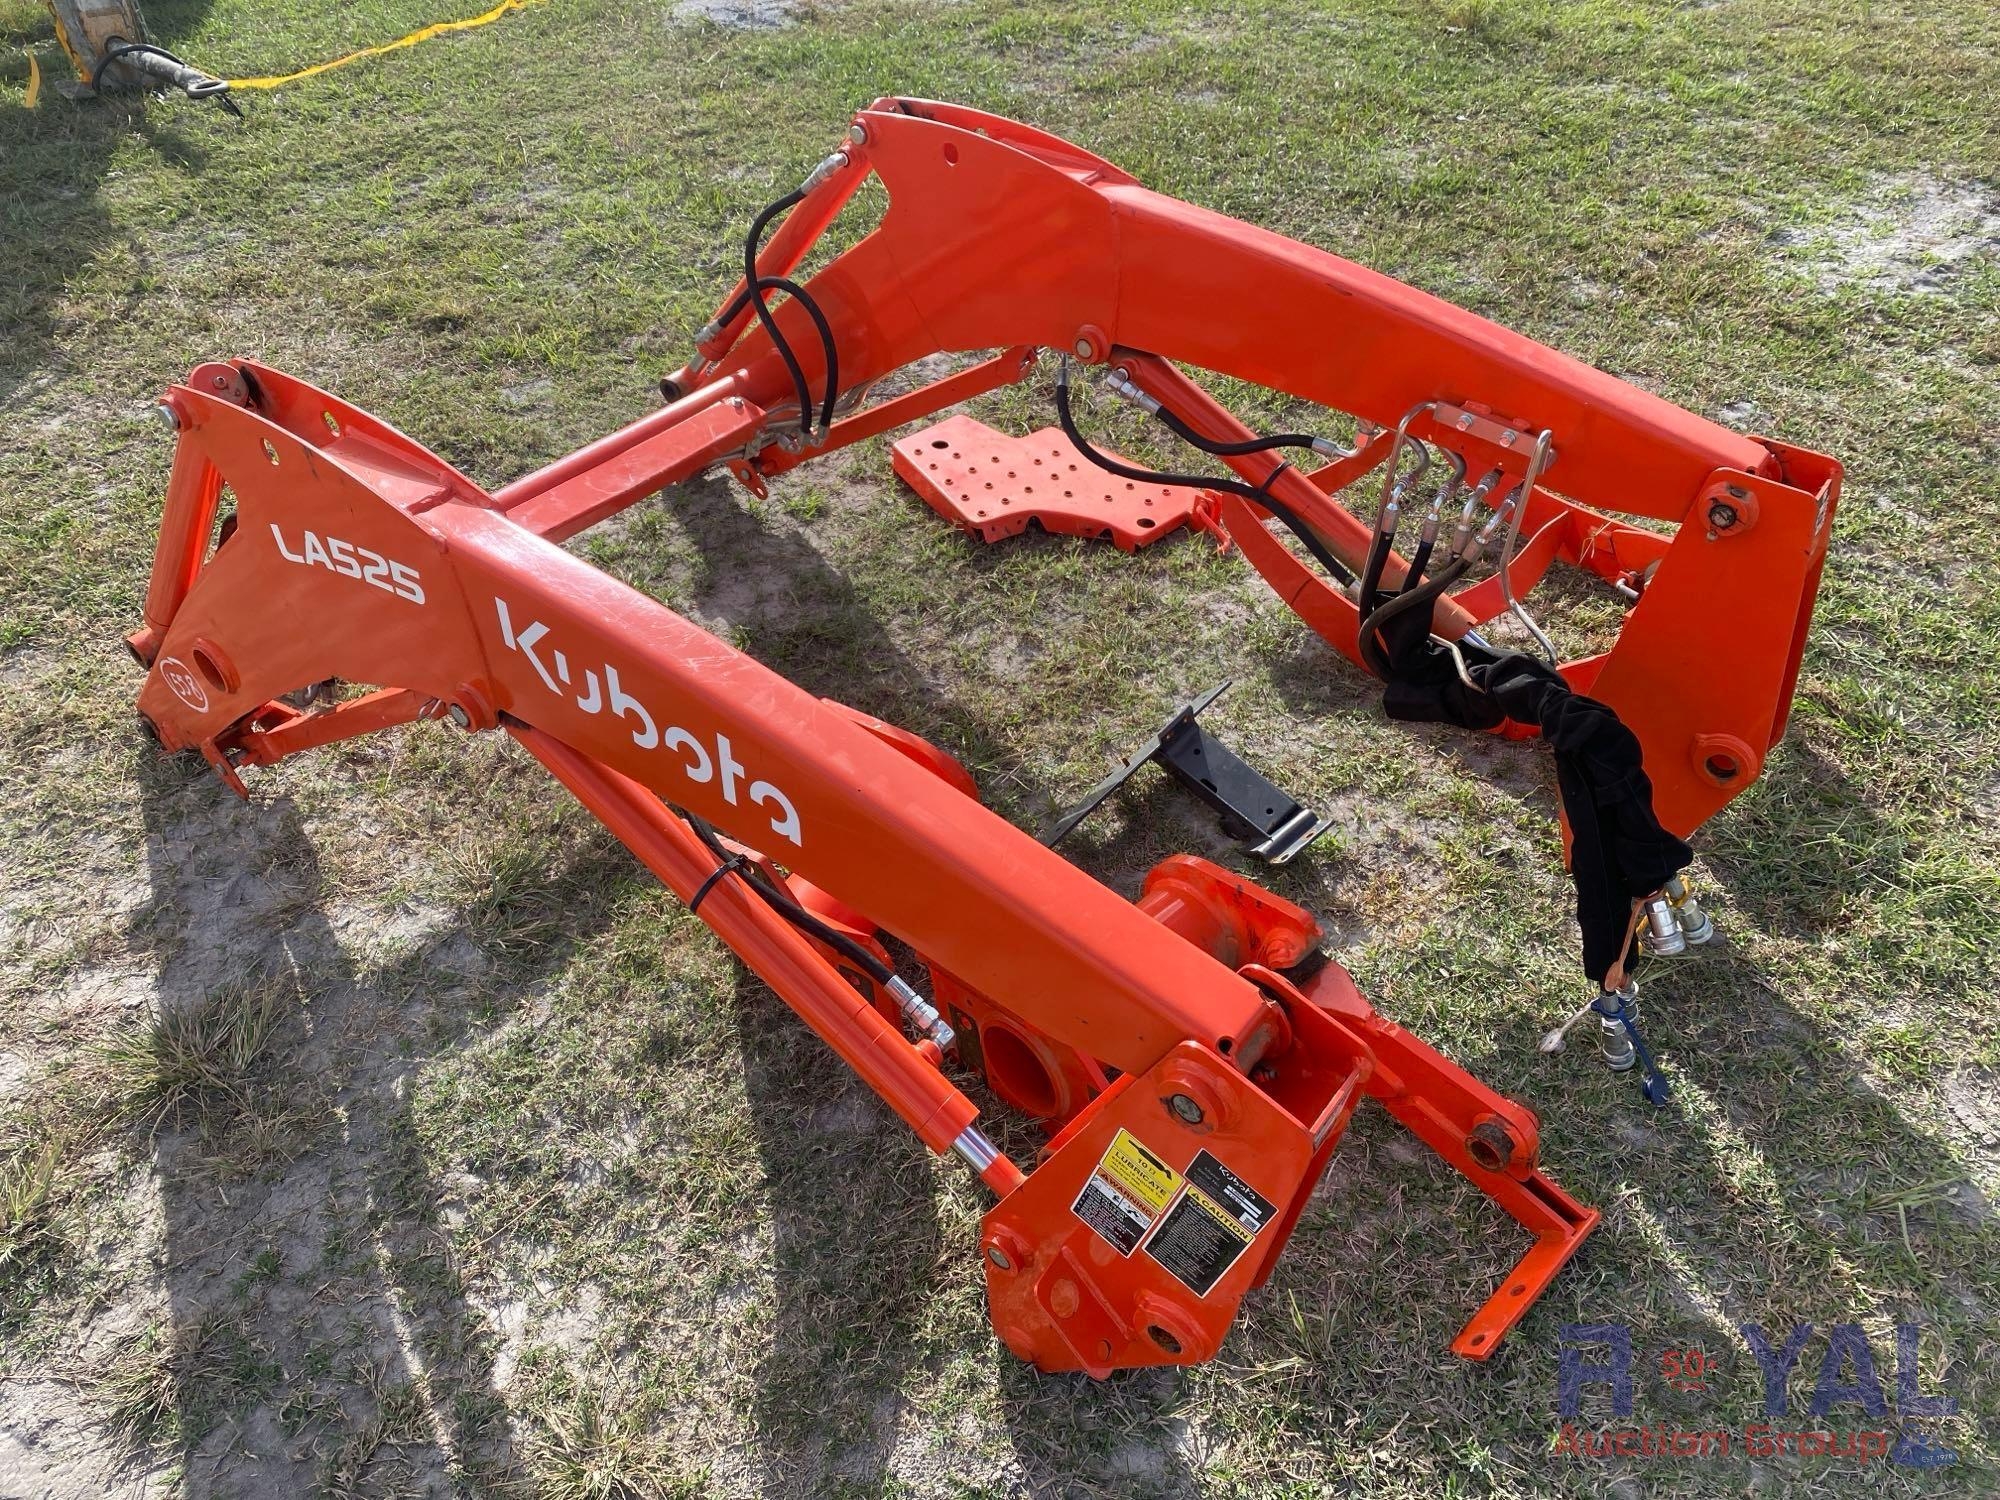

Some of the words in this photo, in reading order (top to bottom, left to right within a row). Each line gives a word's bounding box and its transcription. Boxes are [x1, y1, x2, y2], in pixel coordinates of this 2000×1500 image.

[270, 523, 425, 605] LA525
[495, 596, 802, 847] Kubota
[1114, 1151, 1167, 1196] LUBRICATE
[1217, 1165, 1258, 1200] Kubota
[1107, 1177, 1153, 1217] WARNING
[1201, 1199, 1248, 1239] CAUTION
